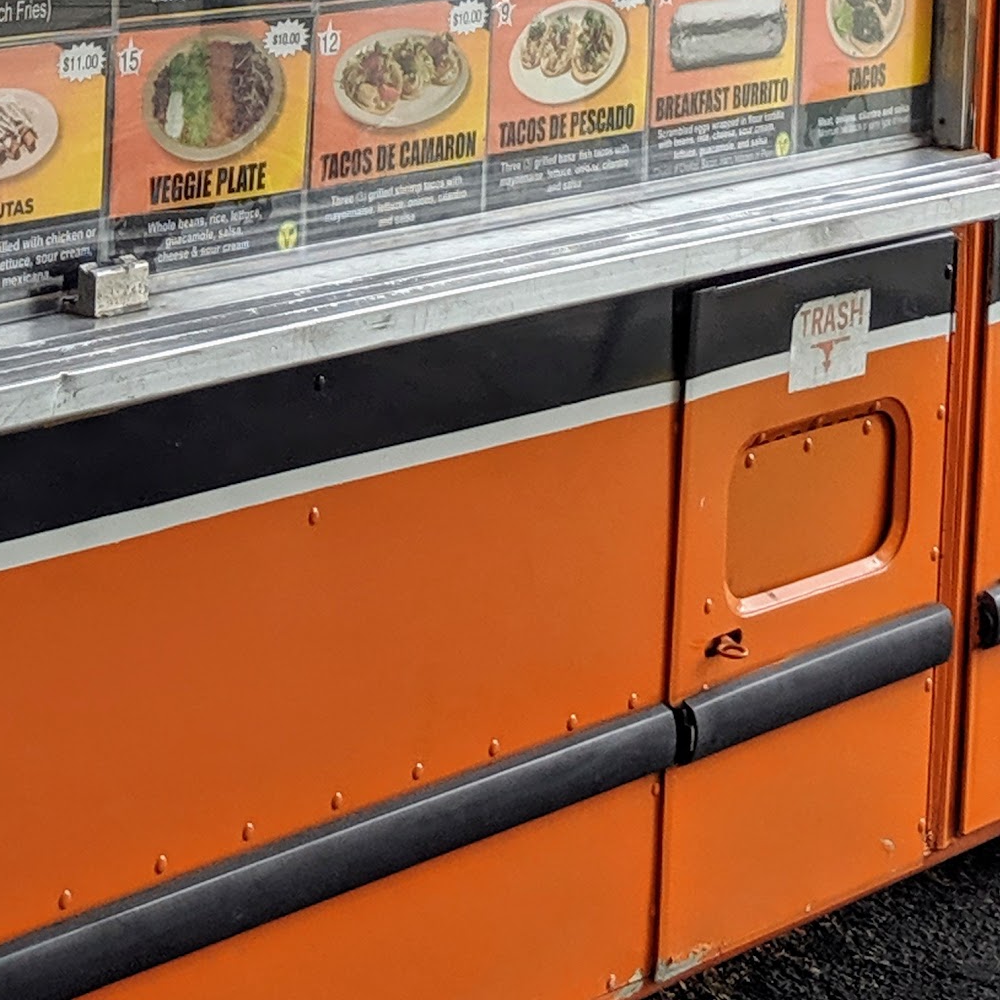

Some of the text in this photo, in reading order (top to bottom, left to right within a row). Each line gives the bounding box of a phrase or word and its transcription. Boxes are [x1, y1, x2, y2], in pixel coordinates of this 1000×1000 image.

[501, 2, 509, 22] 9
[322, 33, 338, 53] 12
[62, 54, 98, 73] $11.00
[121, 50, 139, 72] 15
[848, 63, 886, 92] TACOS
[656, 77, 789, 122] BREAKFAST BURRITO
[499, 103, 635, 147] TACOS DE PESCADO
[321, 148, 372, 182] TACOS
[376, 143, 395, 172] DE
[399, 130, 477, 169] CAMARON
[150, 162, 267, 205] VEGGIE PLATE
[800, 297, 863, 337] TRASH
